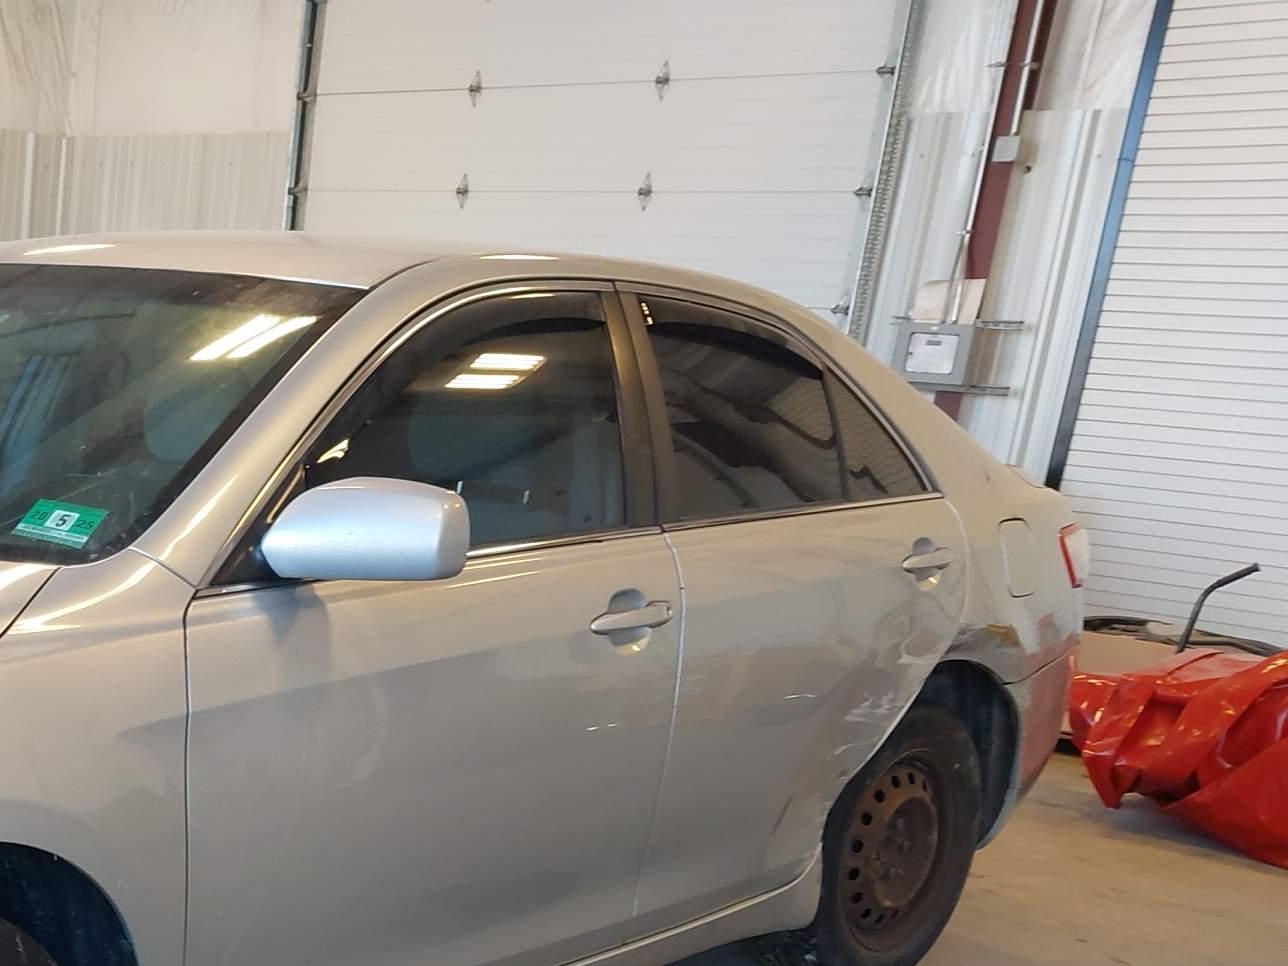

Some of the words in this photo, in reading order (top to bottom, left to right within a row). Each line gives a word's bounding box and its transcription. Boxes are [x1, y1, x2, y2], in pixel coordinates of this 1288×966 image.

[31, 510, 49, 521] 20
[55, 513, 71, 528] 5
[75, 519, 95, 530] 25
